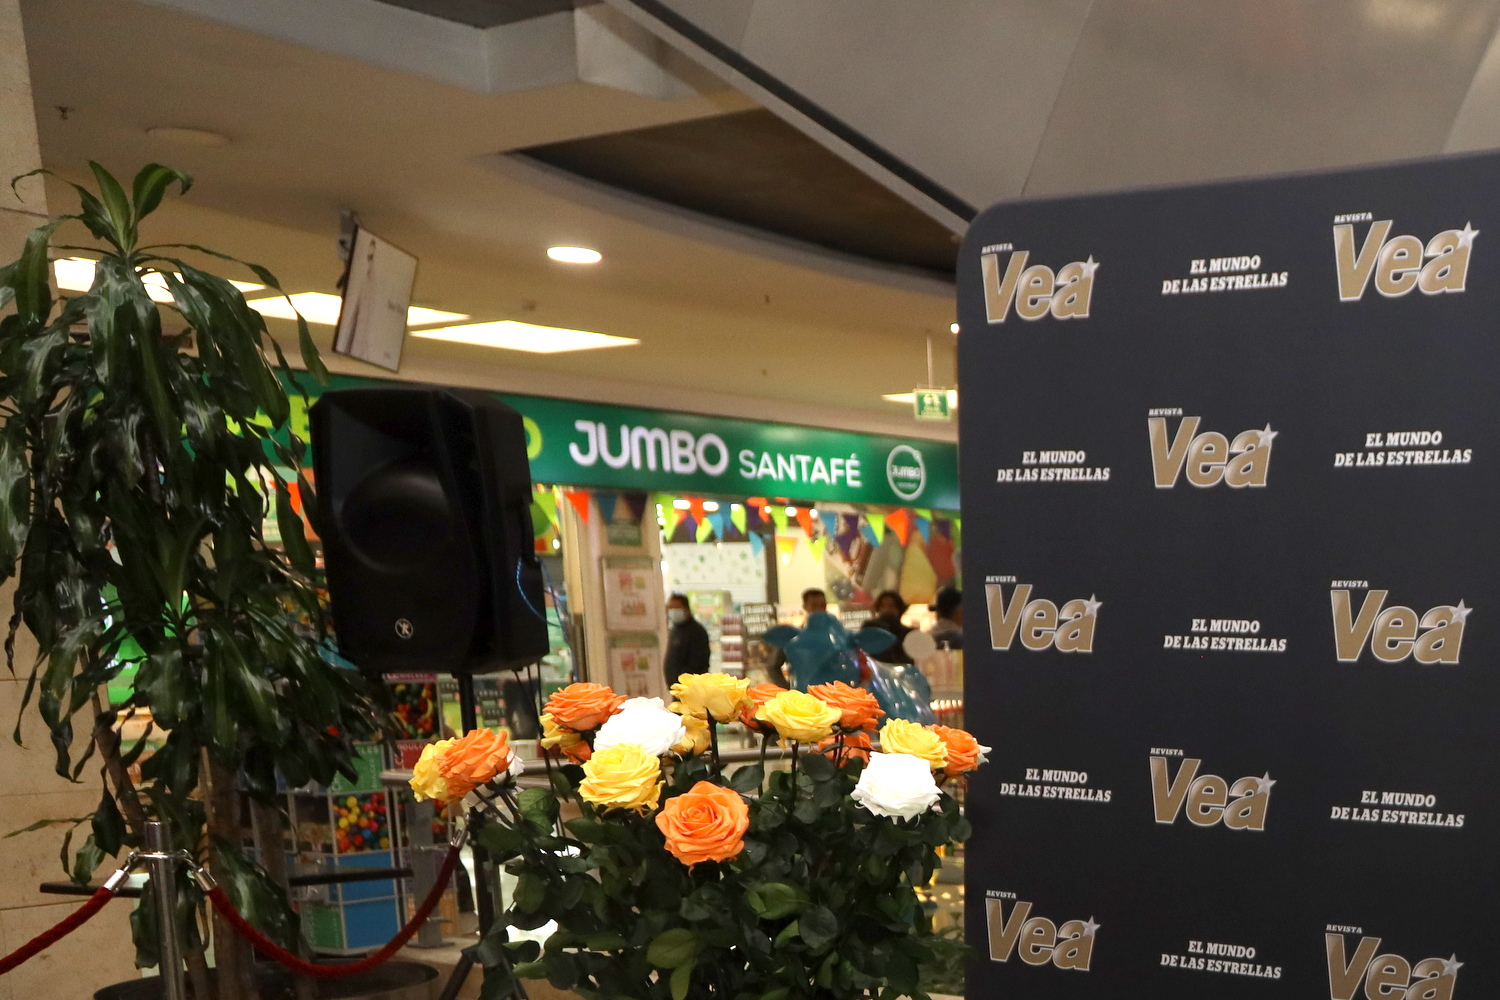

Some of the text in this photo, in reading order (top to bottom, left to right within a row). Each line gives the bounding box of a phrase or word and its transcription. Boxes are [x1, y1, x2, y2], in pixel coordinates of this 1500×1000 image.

[1334, 212, 1371, 223] REVISTA
[981, 244, 1012, 253] REVISTA
[1190, 255, 1260, 273] EL MUNDO
[1333, 219, 1473, 300] Vea
[980, 250, 1095, 322] Vea
[1162, 272, 1288, 293] DE LAS ESTRELLAS
[1148, 408, 1182, 416] REVISTA
[569, 419, 863, 488] JUMBO SANTAFÉ
[1022, 450, 1085, 464] EL MUNDO
[1147, 416, 1273, 488] Vea
[997, 467, 1110, 481] DE LAS ESTRELLAS
[986, 890, 1015, 899] REVISTA
[985, 897, 1096, 972] Vea
[1188, 940, 1255, 959] EL MUNDO
[1160, 953, 1282, 978] DE LAS ESTRELLAS
